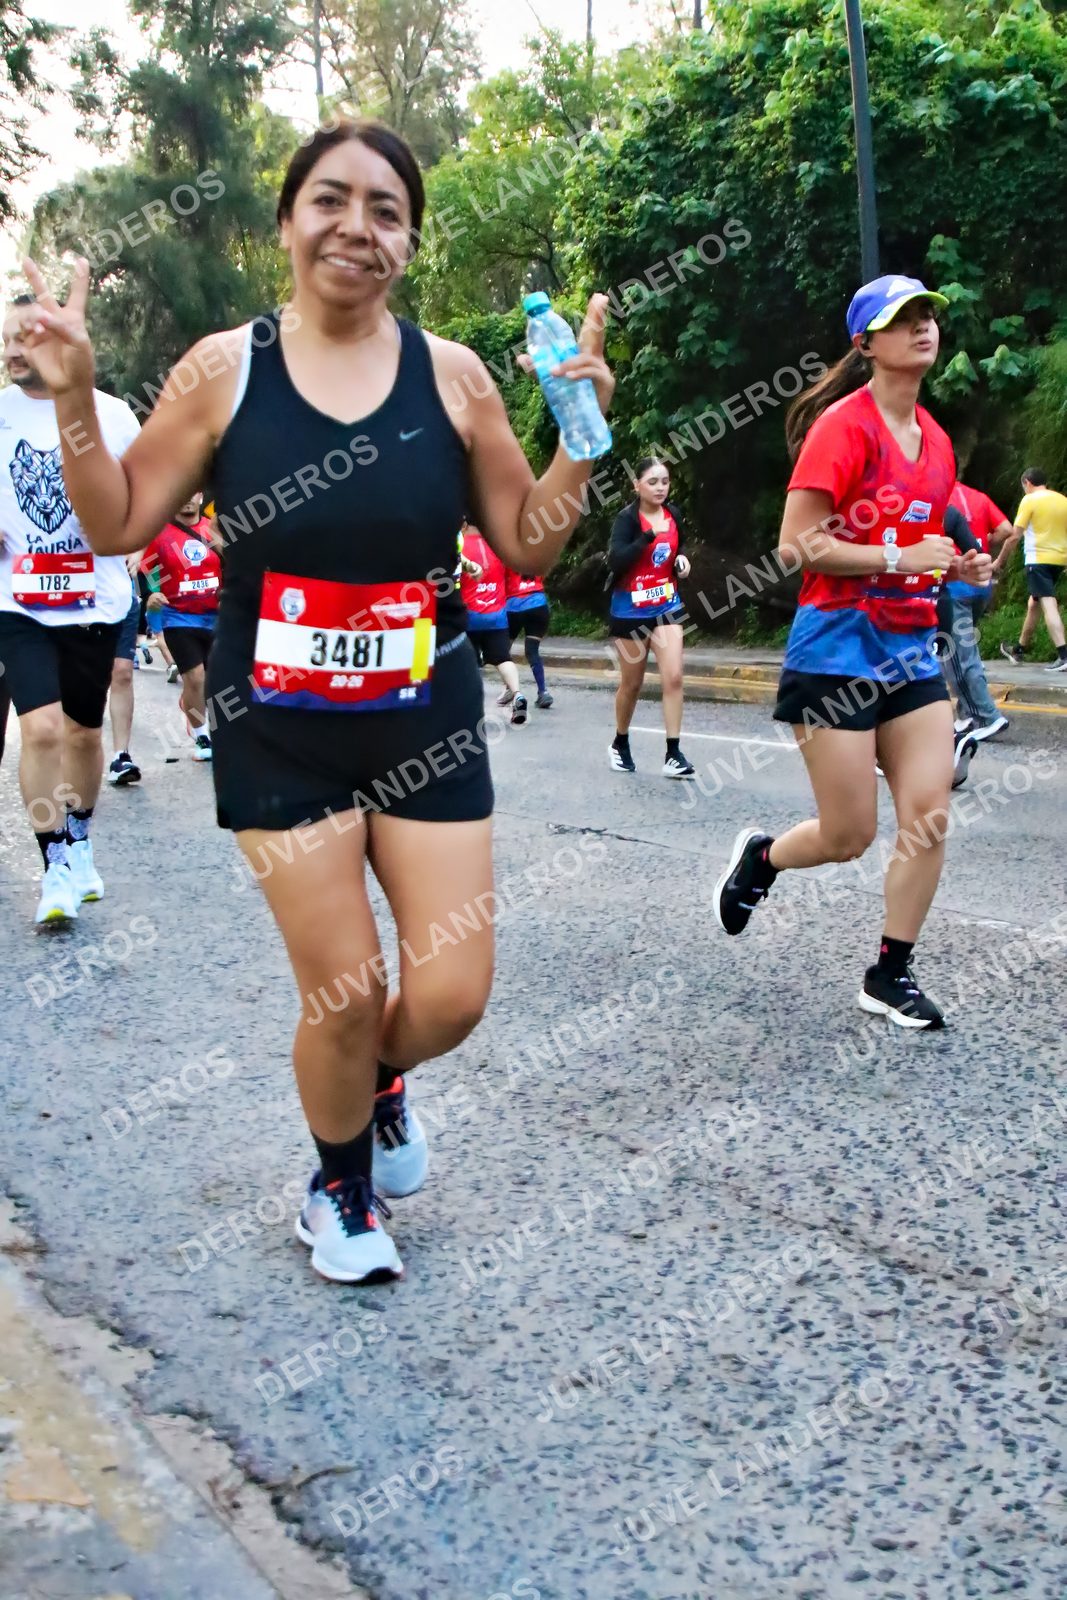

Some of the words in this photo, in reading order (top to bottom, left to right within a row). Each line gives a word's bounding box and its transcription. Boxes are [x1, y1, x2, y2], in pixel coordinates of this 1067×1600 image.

[26, 534, 43, 544] LA
[39, 575, 71, 591] 1782
[645, 586, 665, 600] 2568
[310, 630, 385, 669] 3481
[329, 674, 365, 689] 20-26
